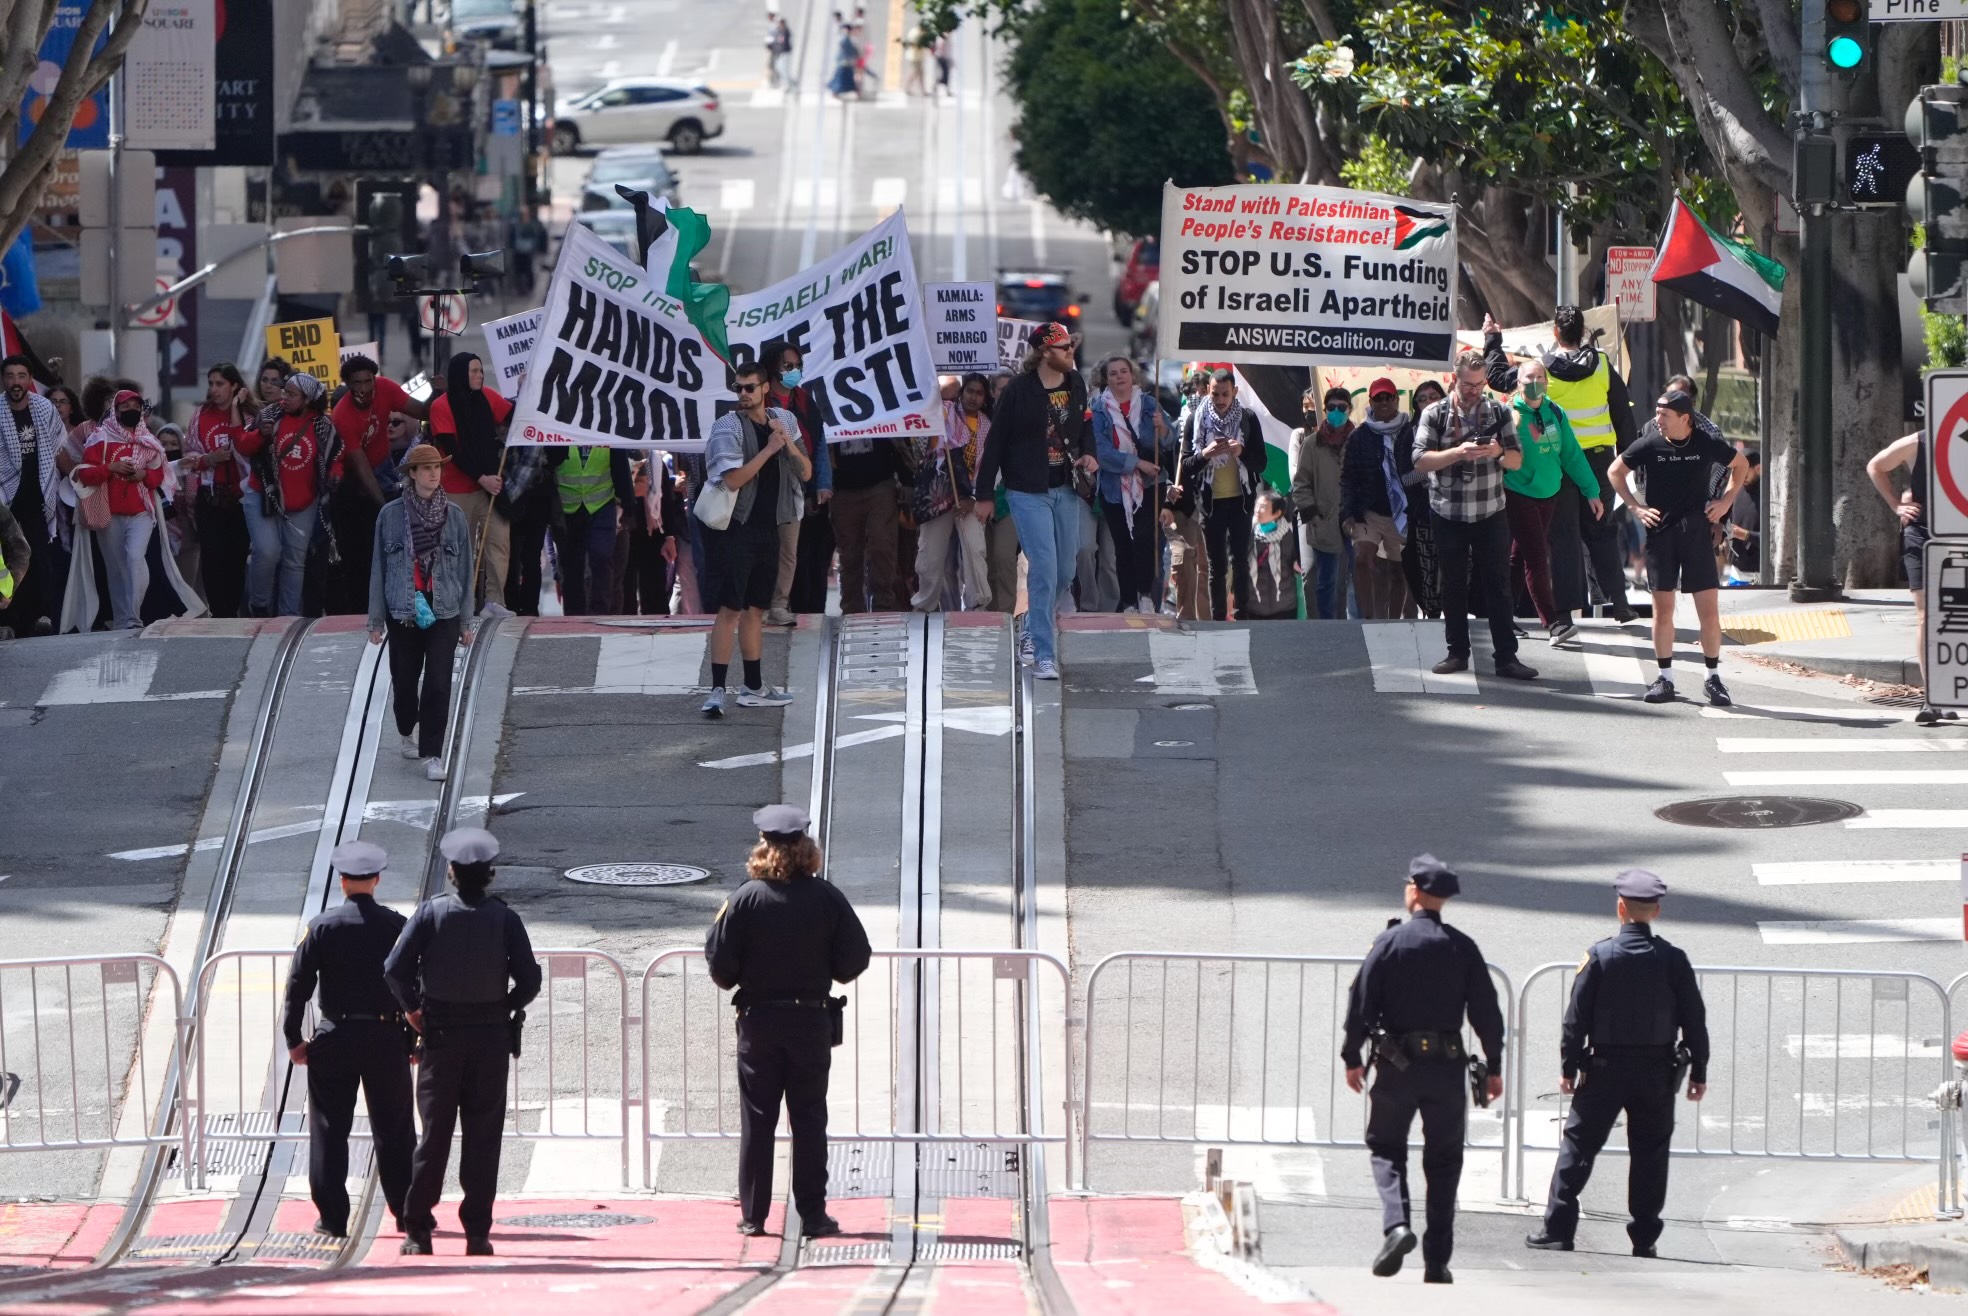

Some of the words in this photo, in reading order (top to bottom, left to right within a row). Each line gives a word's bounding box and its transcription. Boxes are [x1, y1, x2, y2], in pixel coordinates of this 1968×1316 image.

[217, 80, 259, 96] ART
[217, 102, 258, 119] ITY
[1183, 192, 1237, 212] Stand
[1241, 195, 1280, 215] with
[1286, 196, 1391, 221] Palestinian
[1181, 217, 1262, 242] People’s
[1269, 221, 1390, 245] Resistance!
[584, 256, 638, 293] STOP
[841, 235, 893, 285] WAR!
[1181, 249, 1260, 275] STOP
[1270, 252, 1331, 278] U.S.
[1344, 255, 1448, 292] Funding
[1609, 259, 1622, 273] NO
[1621, 280, 1642, 290] ANY
[937, 289, 984, 303] KAMALA:
[1180, 285, 1208, 310] of
[1218, 286, 1309, 313] Israeli
[1320, 289, 1449, 321] Apartheid
[1619, 293, 1644, 304] TIME
[945, 309, 976, 322] ARMS
[280, 324, 322, 350] END
[558, 280, 703, 393] HANDS
[824, 270, 909, 360] THE
[936, 331, 988, 345] EMBARGO
[1225, 327, 1415, 357] ANSWERCoalition.org
[291, 349, 316, 365] ALL
[948, 350, 978, 363] NOW!
[307, 364, 329, 379] AID
[801, 341, 924, 428] AST!
[903, 417, 930, 431] PSL
